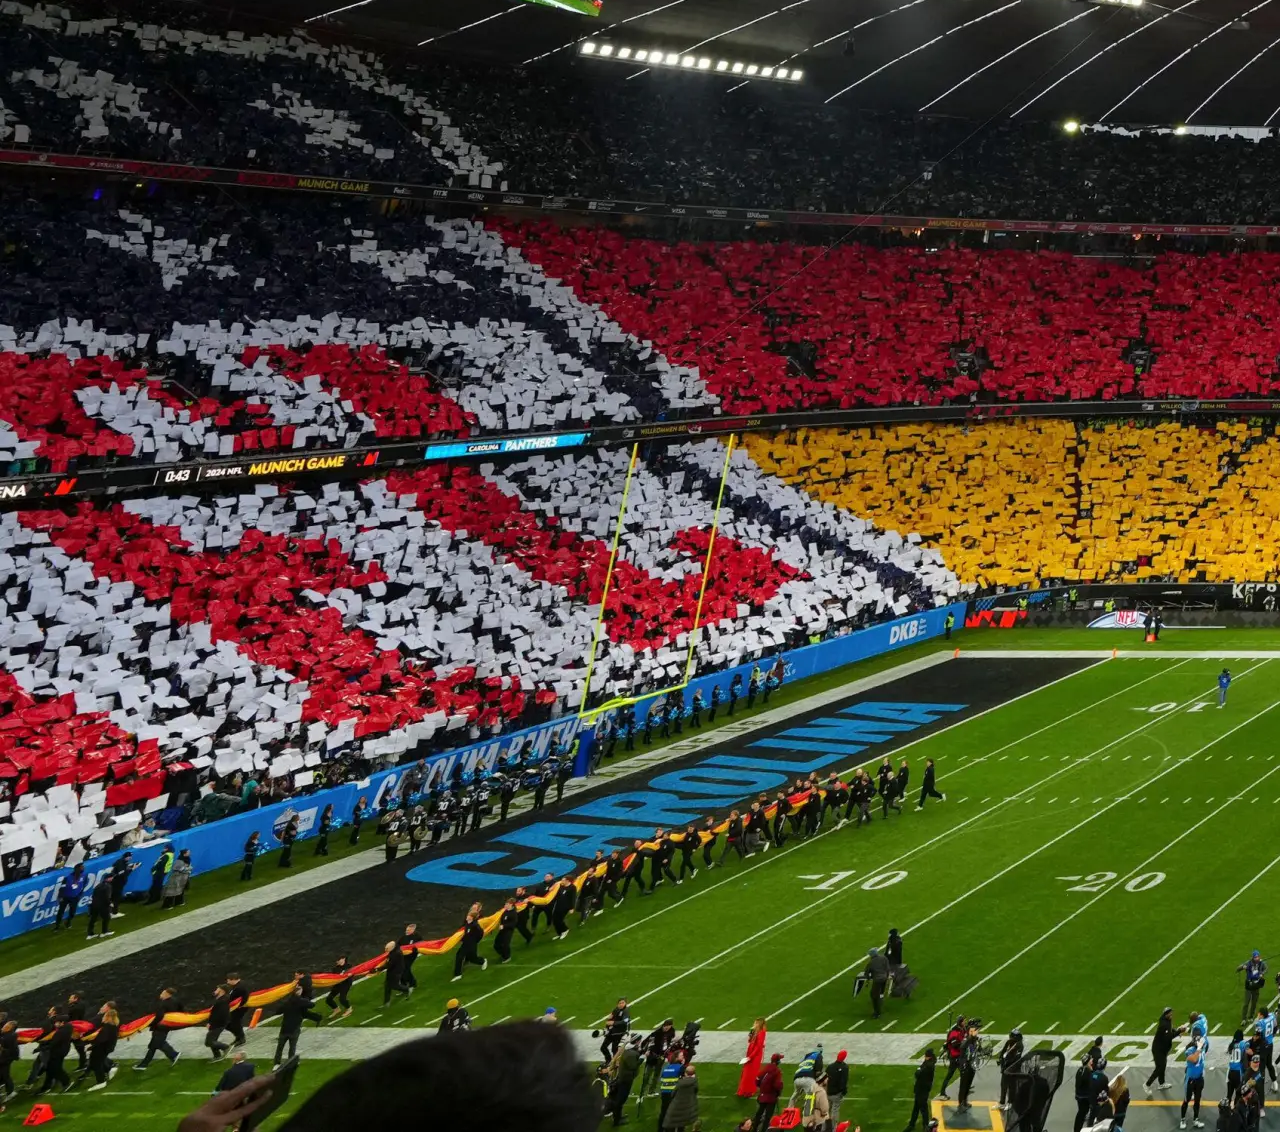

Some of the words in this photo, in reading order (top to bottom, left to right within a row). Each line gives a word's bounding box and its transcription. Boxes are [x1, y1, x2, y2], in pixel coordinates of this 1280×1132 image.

[297, 179, 339, 191] MUNICH
[340, 180, 370, 192] GAME
[468, 443, 500, 453] CAROLINA
[505, 437, 559, 452] PANTHERS
[165, 469, 190, 483] 0:43
[206, 469, 226, 478] 2024
[226, 466, 243, 476] NFL
[248, 458, 306, 476] MUNICH
[306, 455, 346, 470] GAME
[1117, 611, 1135, 623] NFL
[889, 620, 918, 645] DKB
[403, 700, 970, 891] CAROLINA
[803, 869, 910, 891] 10
[1066, 871, 1168, 892] 20
[781, 1109, 796, 1126] 20
